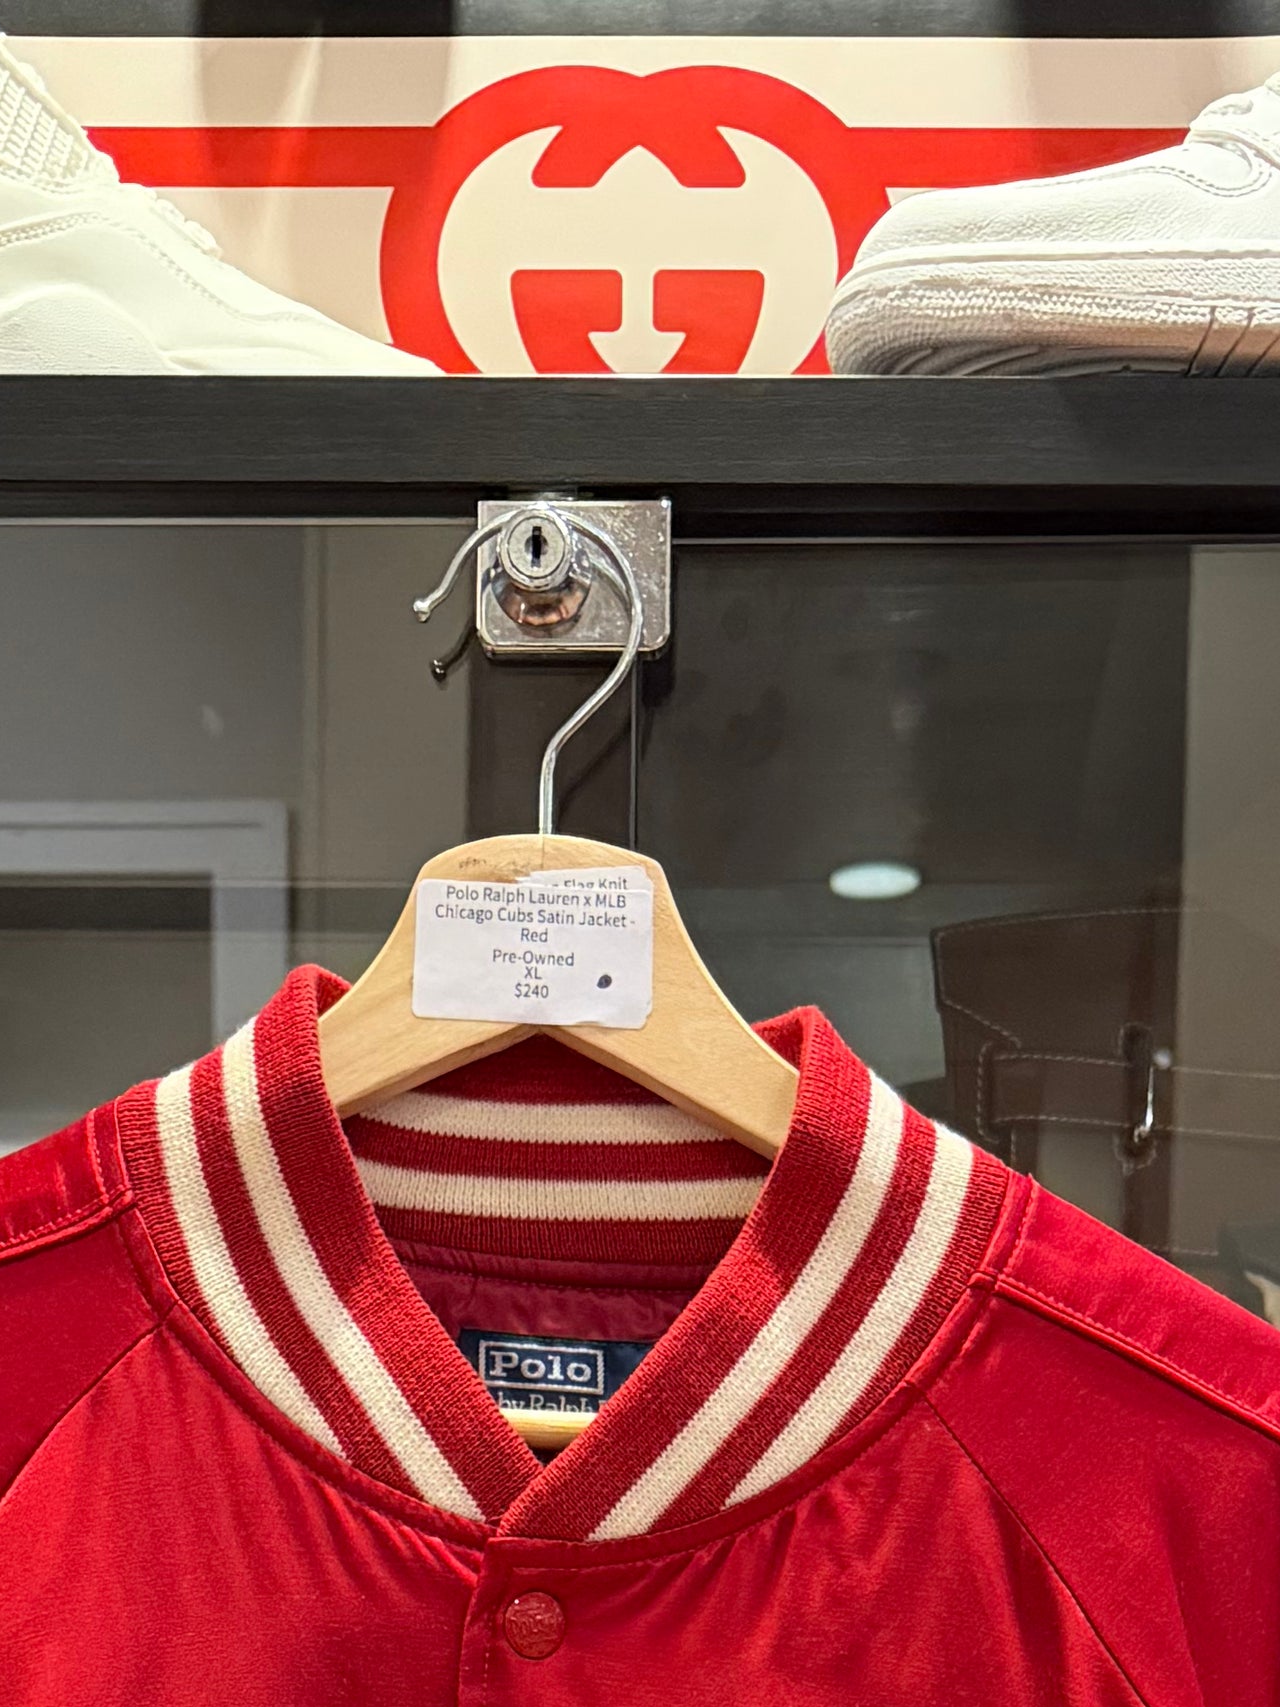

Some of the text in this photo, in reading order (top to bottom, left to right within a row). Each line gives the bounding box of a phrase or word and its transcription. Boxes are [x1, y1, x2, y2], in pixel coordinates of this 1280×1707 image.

[599, 877, 628, 890] Knit
[446, 885, 627, 909] Polo Ralph Lauren x MLB
[435, 904, 493, 924] Chicago
[497, 907, 534, 923] Cubs
[537, 909, 575, 925] Satin
[579, 911, 627, 928] Jacket
[520, 927, 548, 943] Red
[492, 949, 575, 967] Pre-Owned
[524, 966, 542, 980] XL
[514, 983, 549, 999] $240
[489, 1351, 592, 1383] Polo
